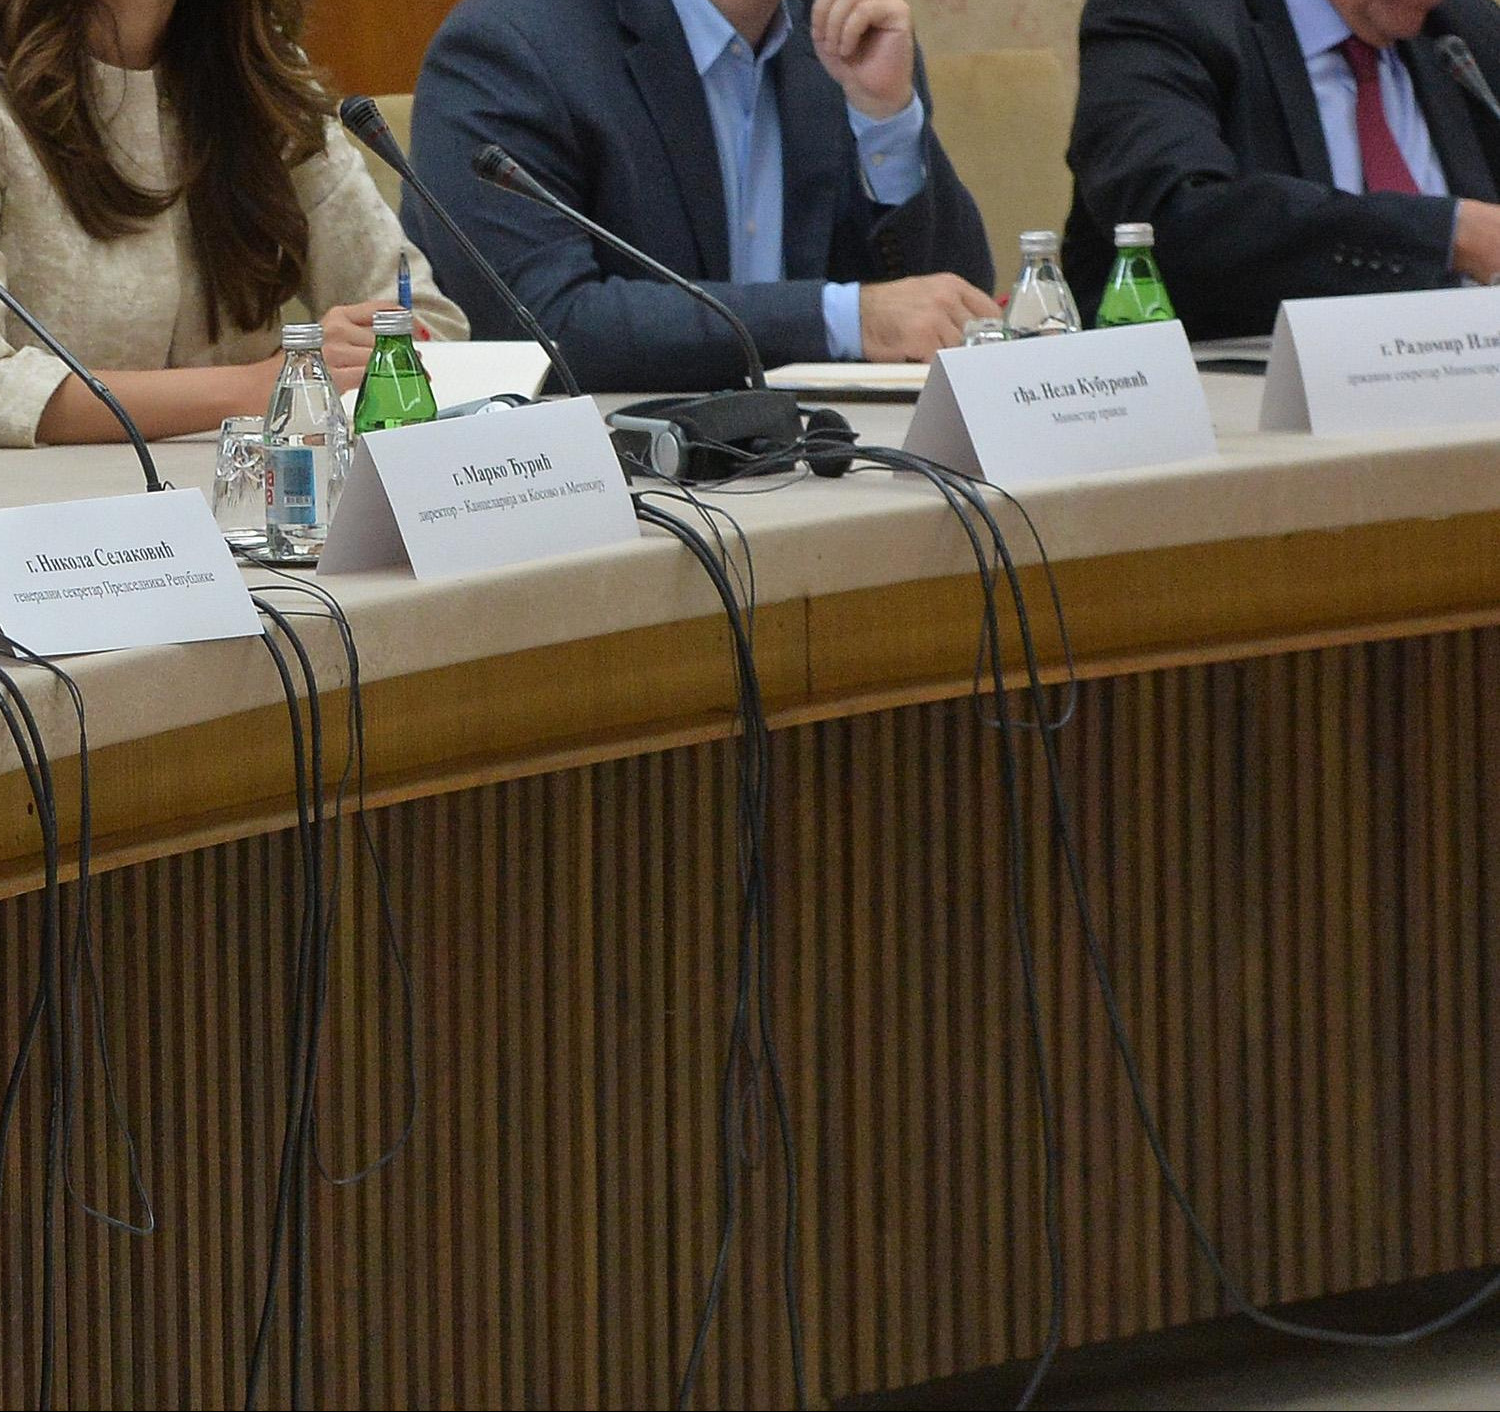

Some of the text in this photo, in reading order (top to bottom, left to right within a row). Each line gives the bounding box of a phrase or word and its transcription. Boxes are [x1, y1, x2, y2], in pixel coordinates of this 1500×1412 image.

[1394, 338, 1463, 356] Радомир
[1041, 381, 1076, 399] Нела
[1076, 370, 1148, 398] Кубуровић
[452, 453, 552, 486] г. Марко Ђурић
[464, 492, 518, 514] Канцеларија
[518, 494, 528, 503] за
[528, 485, 559, 502] Косово
[25, 540, 174, 573] г. Никола Селаковић
[14, 570, 215, 604] генерални секретар Председника Републике
